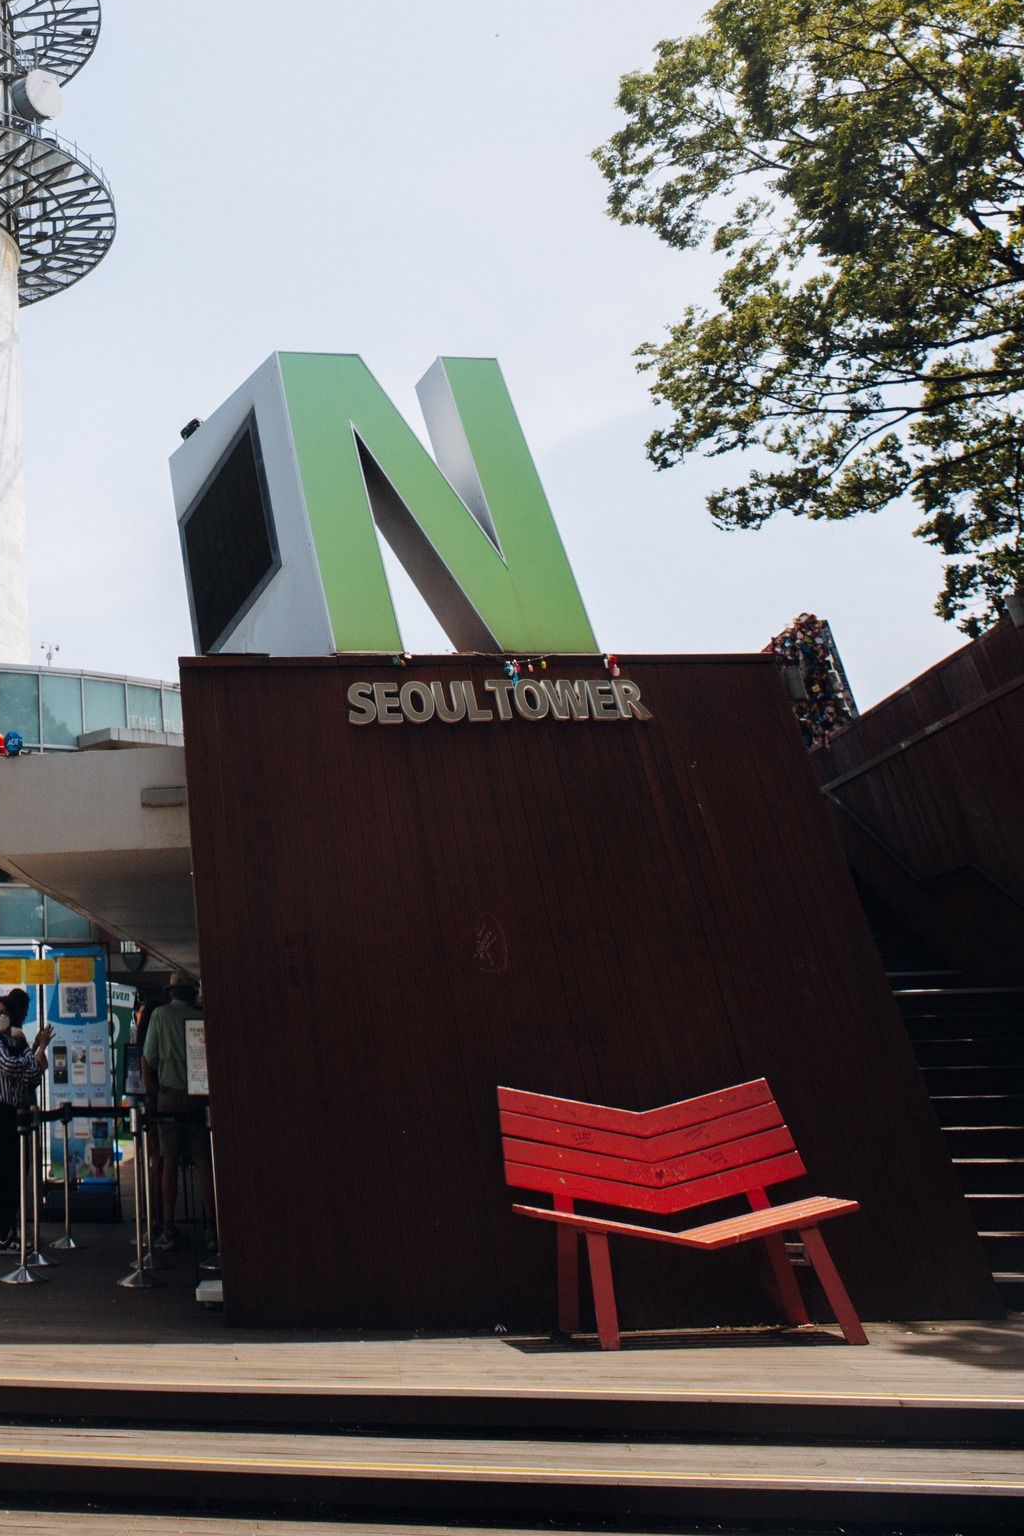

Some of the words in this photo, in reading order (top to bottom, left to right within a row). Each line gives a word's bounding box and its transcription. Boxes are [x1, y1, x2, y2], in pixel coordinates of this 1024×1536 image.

[275, 351, 602, 655] N
[347, 680, 493, 725] SEOUL
[484, 678, 653, 721] TOWER
